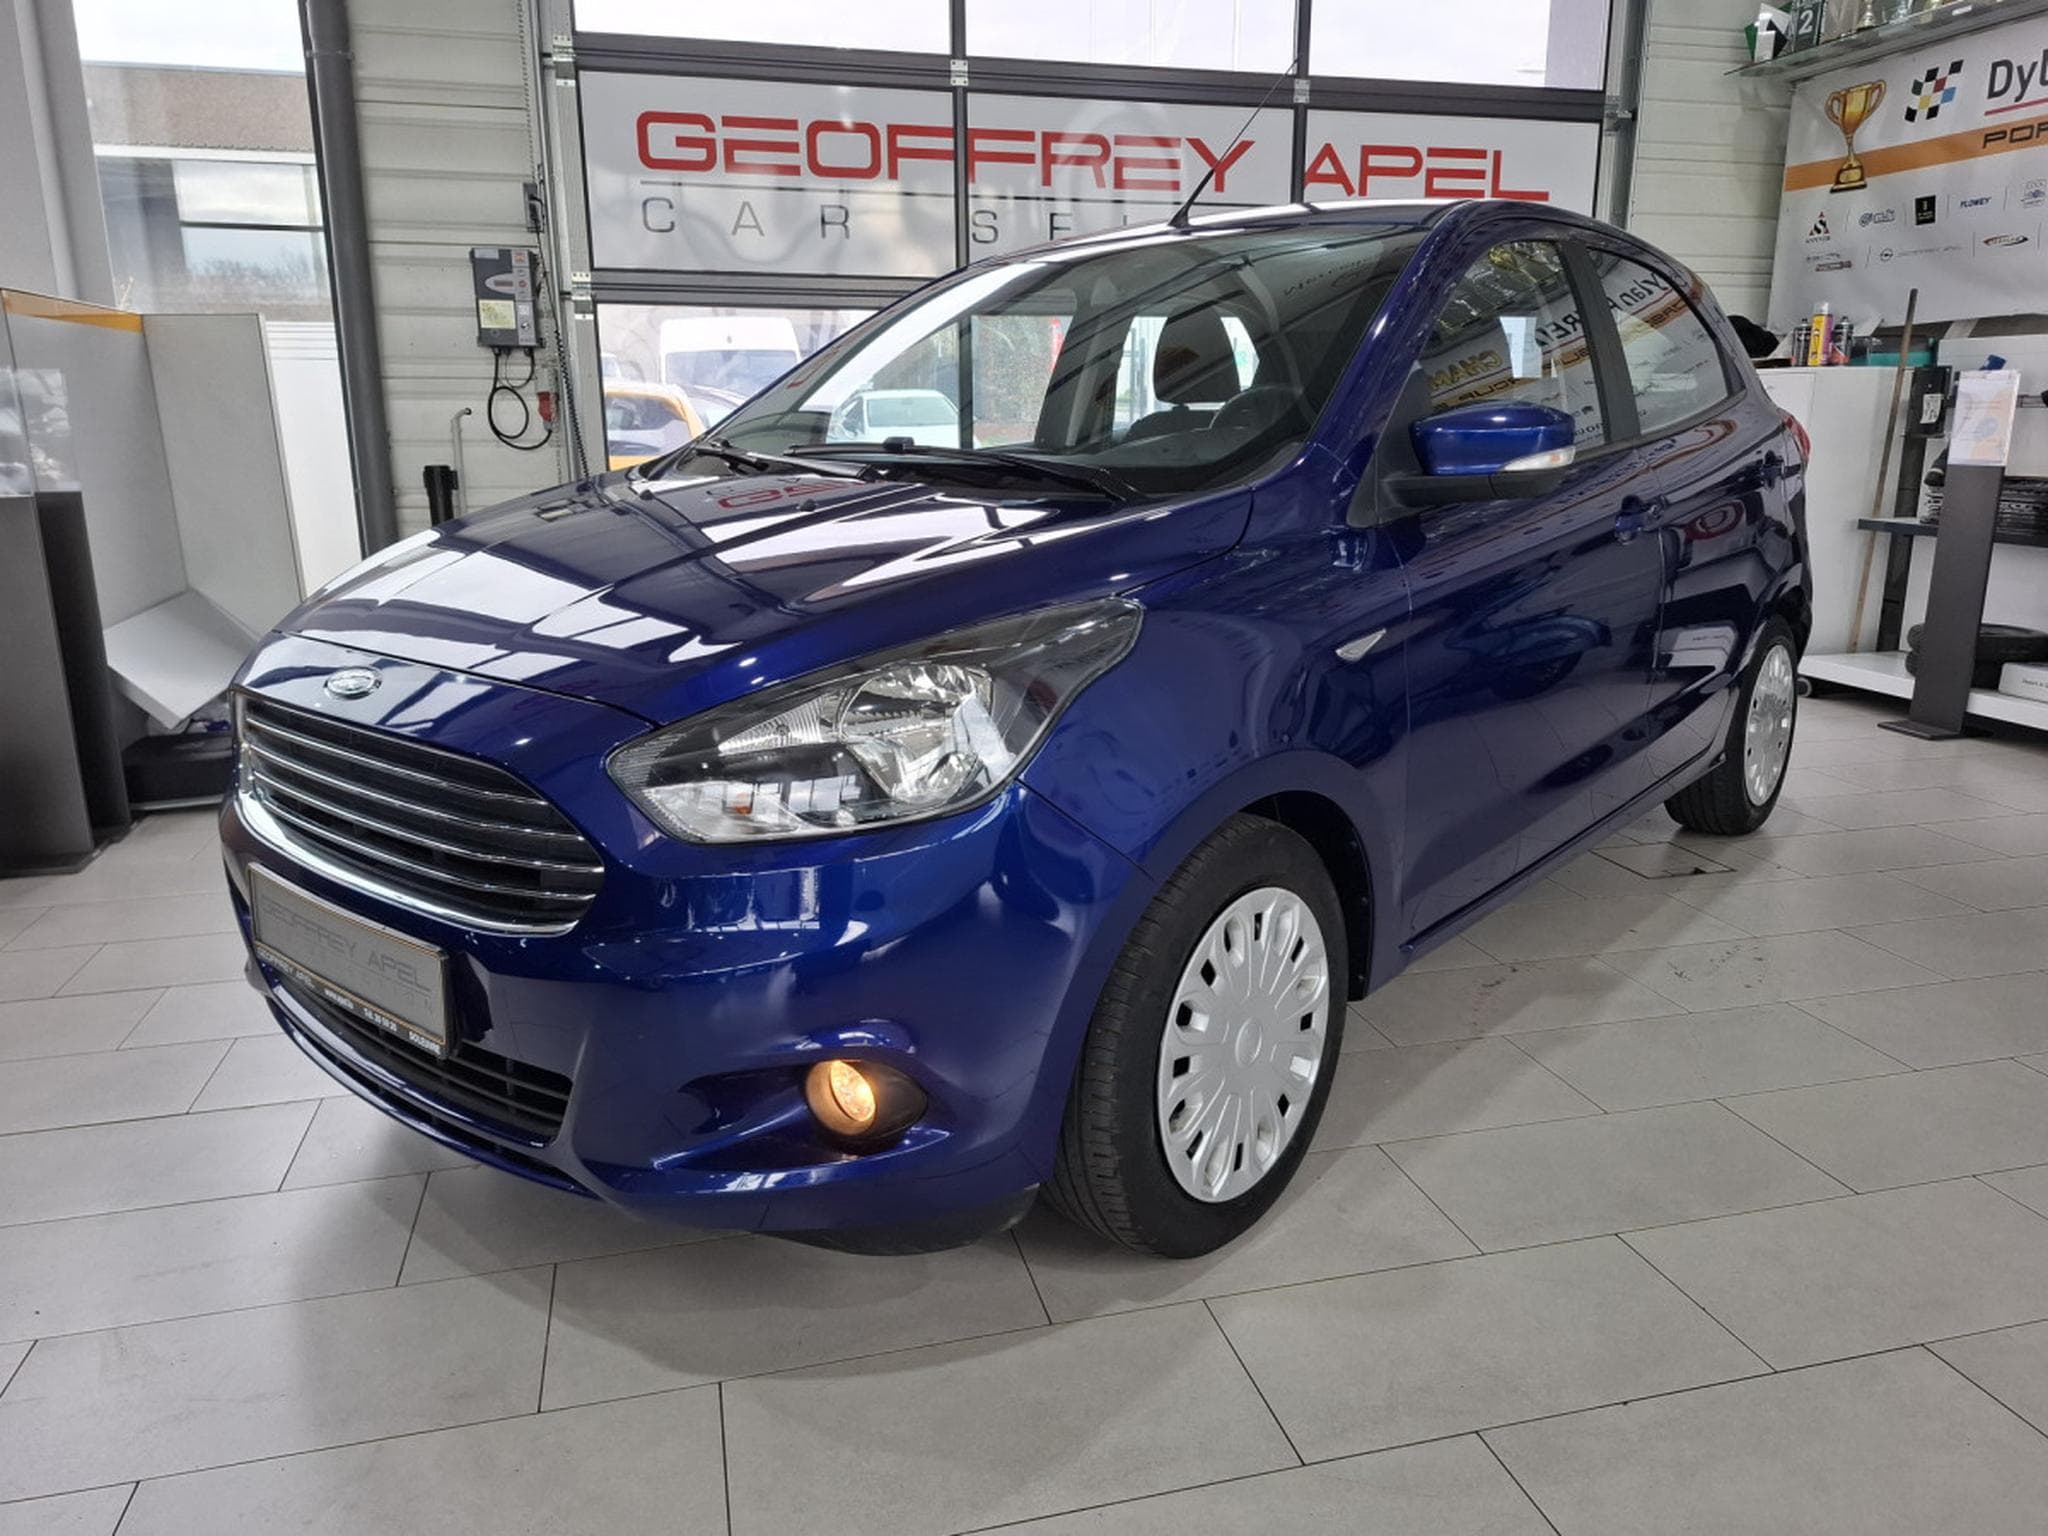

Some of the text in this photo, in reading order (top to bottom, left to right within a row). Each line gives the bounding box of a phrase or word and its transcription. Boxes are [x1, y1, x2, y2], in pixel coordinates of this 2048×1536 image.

[635, 110, 1550, 202] GEOFFREY APEL
[641, 196, 850, 239] CAR
